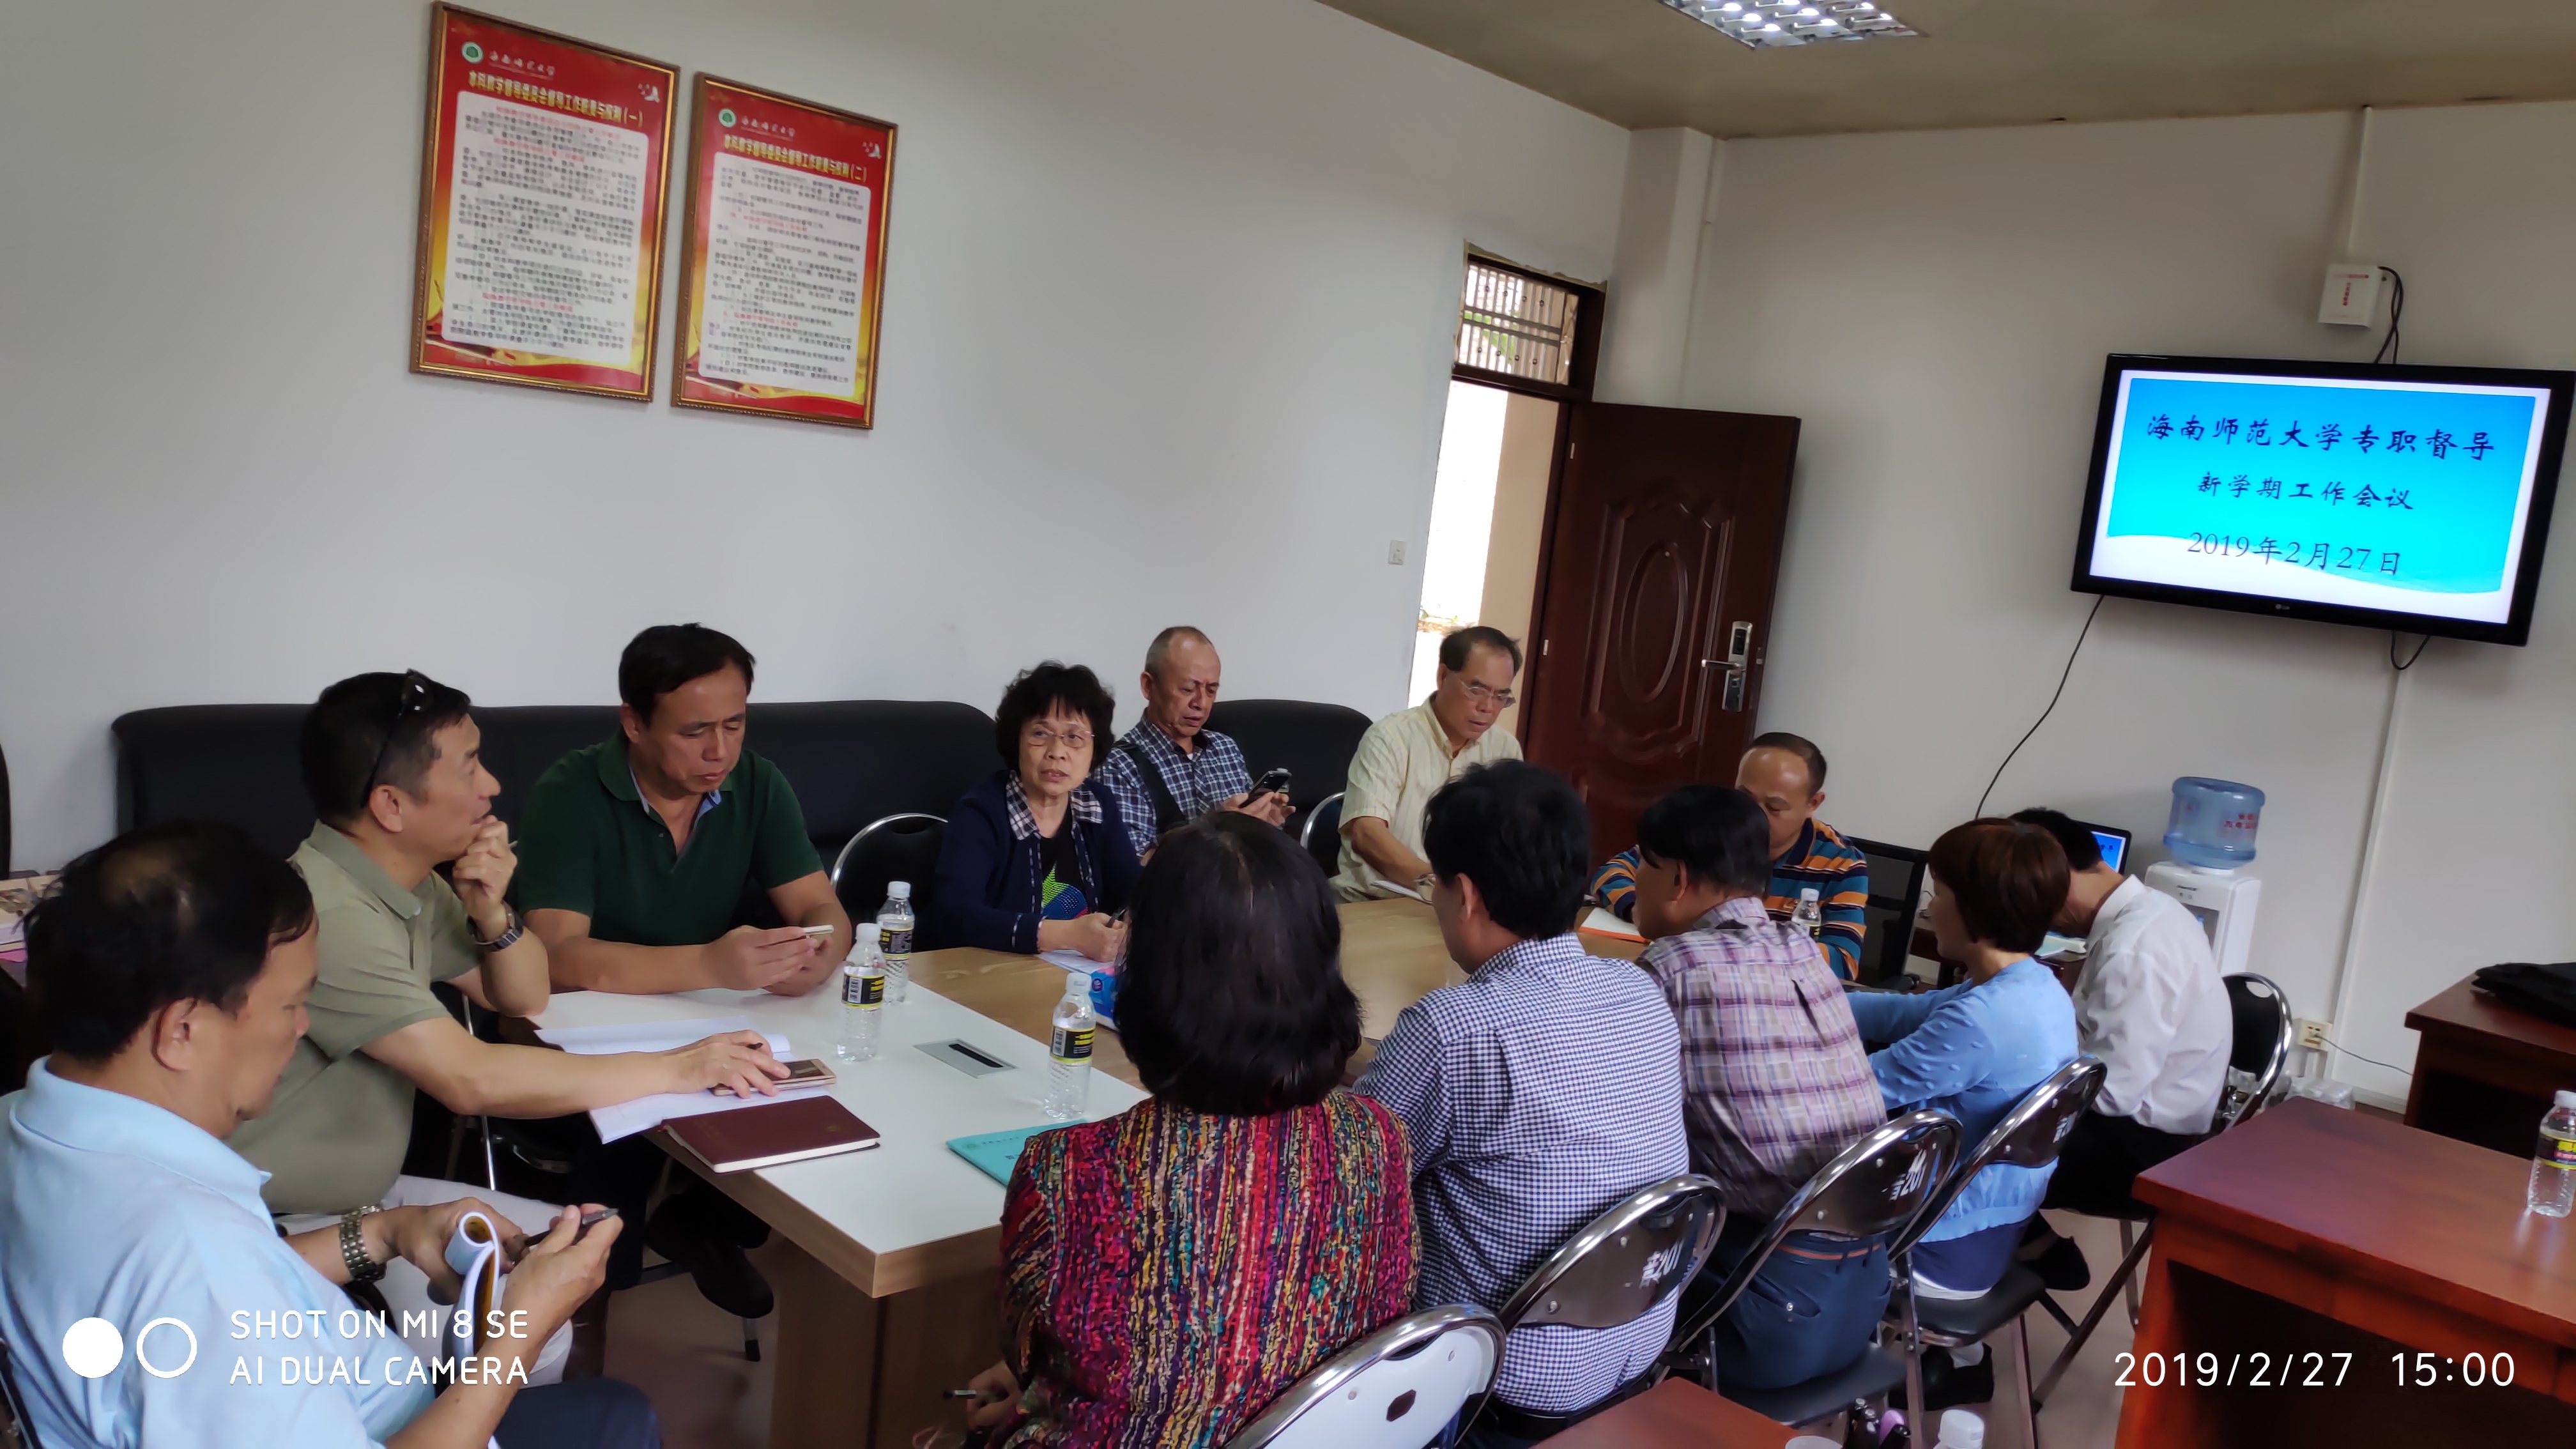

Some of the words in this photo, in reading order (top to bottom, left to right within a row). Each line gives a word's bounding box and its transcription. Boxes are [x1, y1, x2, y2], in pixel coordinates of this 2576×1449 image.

[2147, 413, 2495, 461] 海南师范大学专职督导
[2198, 471, 2413, 510] 新学期工作会议
[2187, 532, 2400, 576] 2019年2月27日
